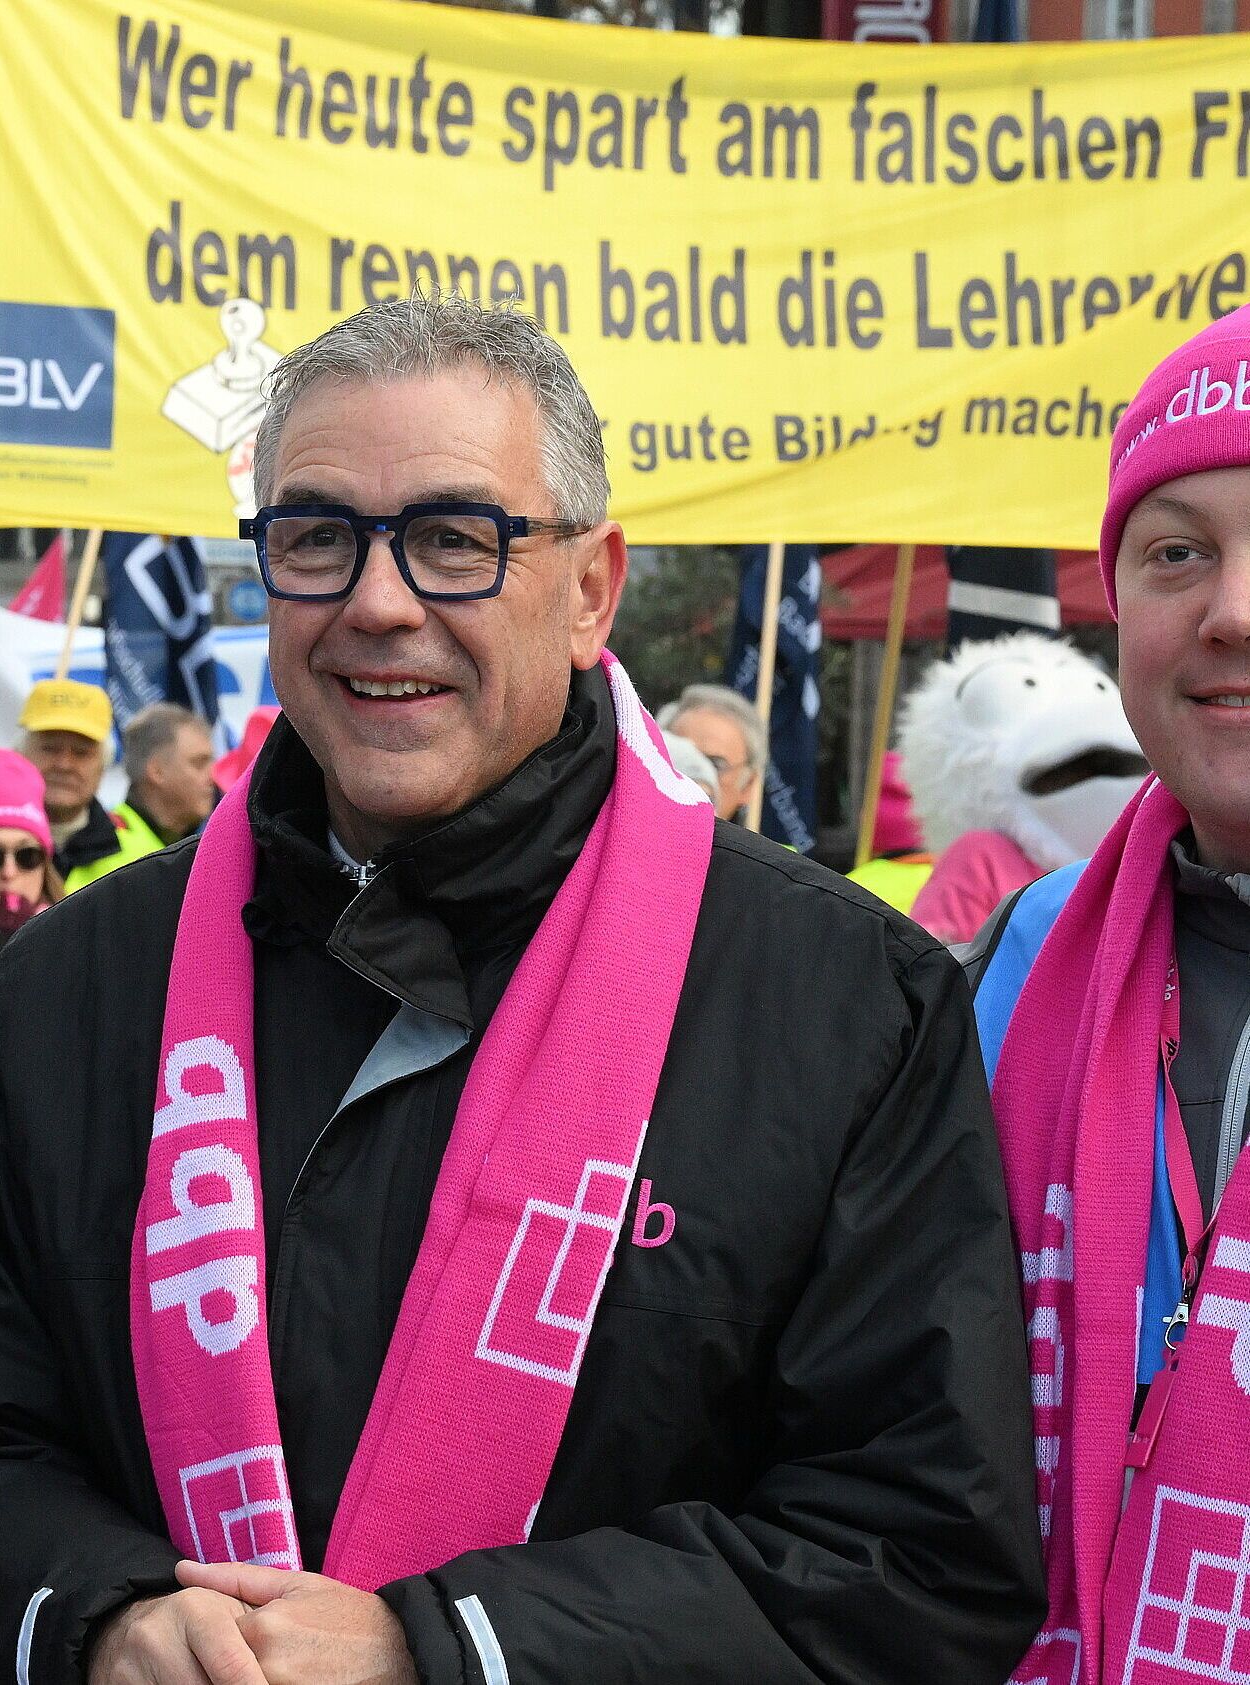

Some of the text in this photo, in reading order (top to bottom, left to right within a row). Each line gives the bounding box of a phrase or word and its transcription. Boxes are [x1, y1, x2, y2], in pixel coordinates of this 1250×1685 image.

[118, 15, 252, 130] Wer
[277, 38, 473, 156] heute
[502, 52, 688, 192] spart
[717, 102, 820, 179] am
[850, 81, 1161, 185] falschen
[146, 201, 296, 311] dem
[331, 238, 568, 334] rennen
[600, 240, 747, 345] bald
[778, 250, 884, 349] die
[630, 415, 750, 472] gute
[631, 1177, 677, 1249] b
